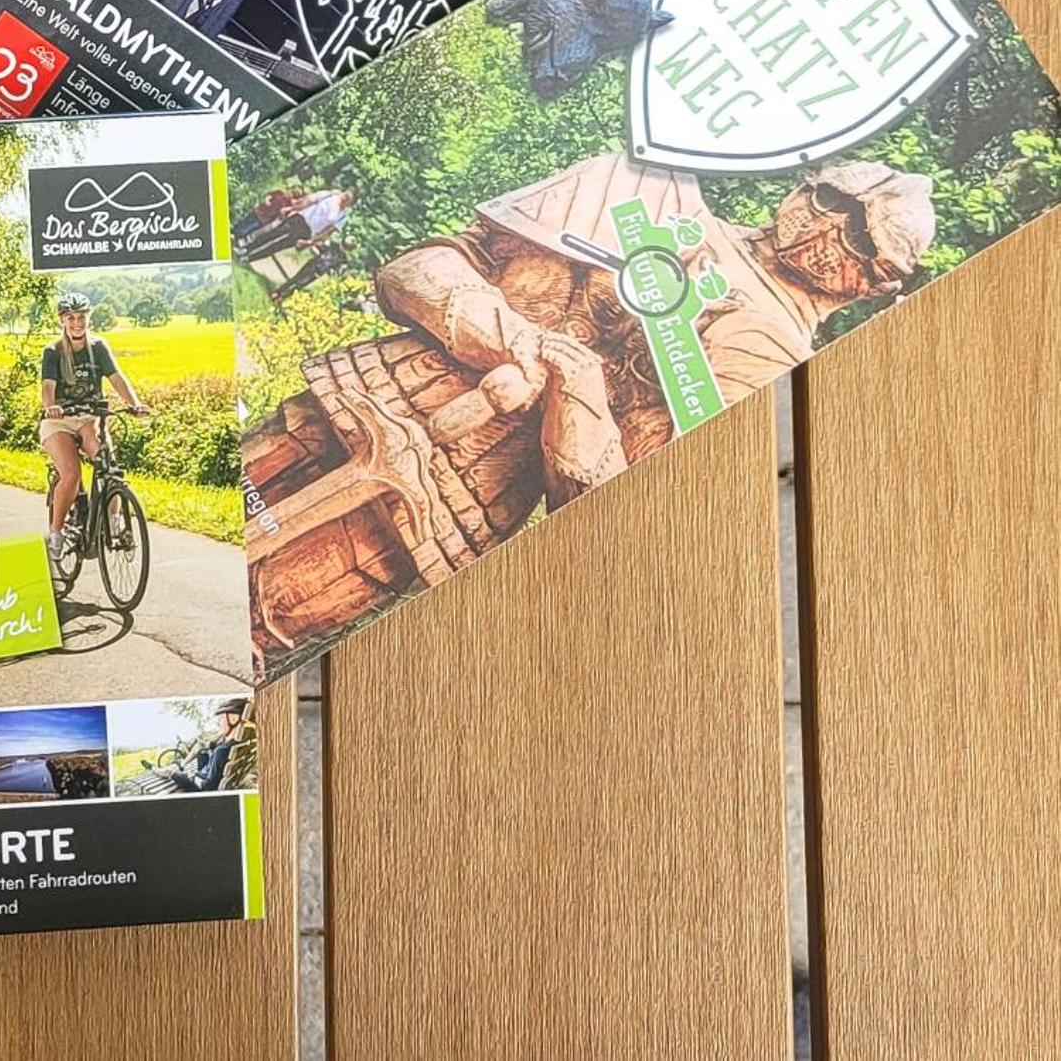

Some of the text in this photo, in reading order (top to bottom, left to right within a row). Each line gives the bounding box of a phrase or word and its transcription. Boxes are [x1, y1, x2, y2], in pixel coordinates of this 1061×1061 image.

[48, 11, 79, 41] Welt
[79, 34, 119, 70] voller
[66, 69, 111, 109] Länge
[654, 27, 763, 139] WEG
[42, 211, 200, 252] Das Bergische
[42, 238, 202, 256] SCHWALBE RADFAHRLAND
[618, 209, 644, 246] Für
[656, 315, 706, 418] Entdecker
[29, 869, 137, 890] Fahrradrouten
